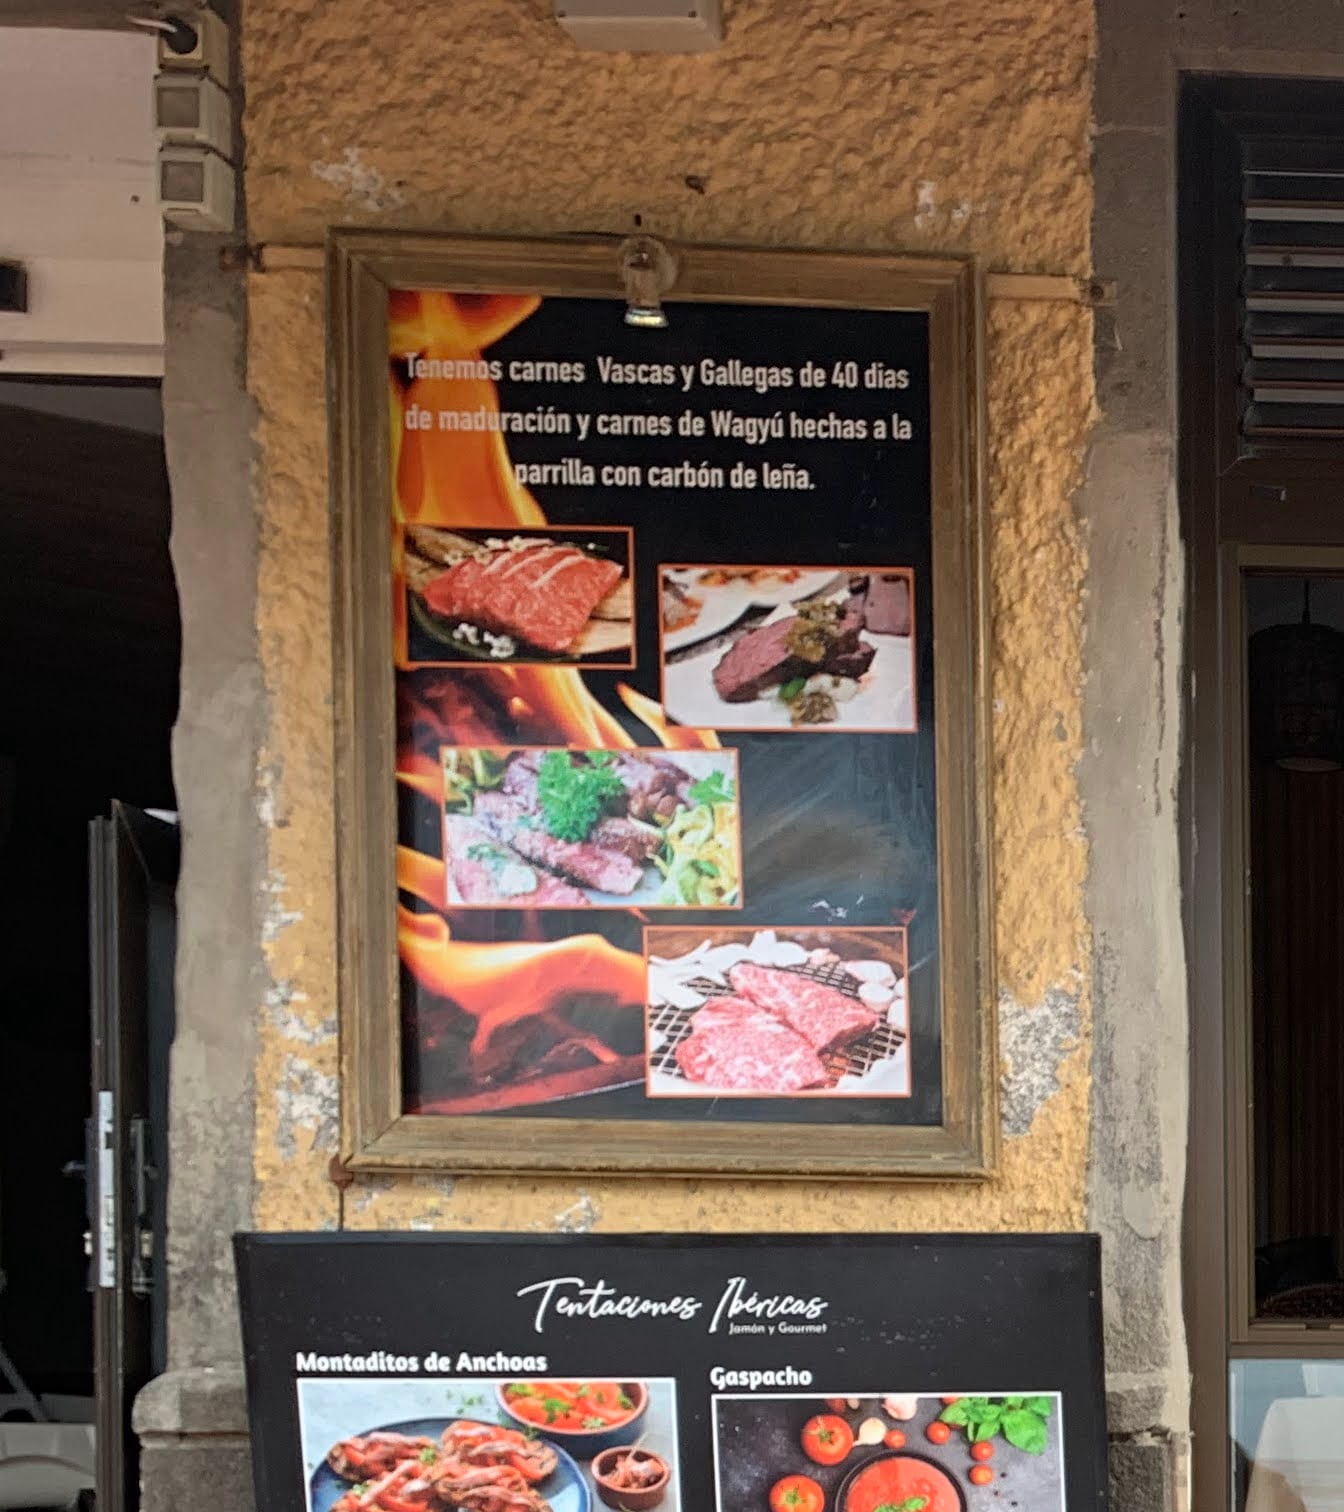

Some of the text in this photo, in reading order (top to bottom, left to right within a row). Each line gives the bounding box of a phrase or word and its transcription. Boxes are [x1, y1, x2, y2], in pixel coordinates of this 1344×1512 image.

[405, 351, 503, 381] Tenemos
[509, 359, 586, 382] carnes
[597, 355, 676, 386] Vascas
[680, 364, 695, 392] y
[700, 358, 794, 394] Gallegas
[799, 360, 826, 389] de
[831, 361, 859, 389] 40
[405, 404, 912, 445] de maduración y carnes de Wagyú hechas a la
[514, 457, 816, 490] parrilla con carbón de leña.
[516, 1276, 829, 1334] Tentaciones Ibéricas
[768, 1325, 775, 1336] y
[778, 1321, 827, 1334] Gourmet
[296, 1351, 548, 1372] Montaditos de Anchoas
[709, 1365, 813, 1391] Gaspacho
